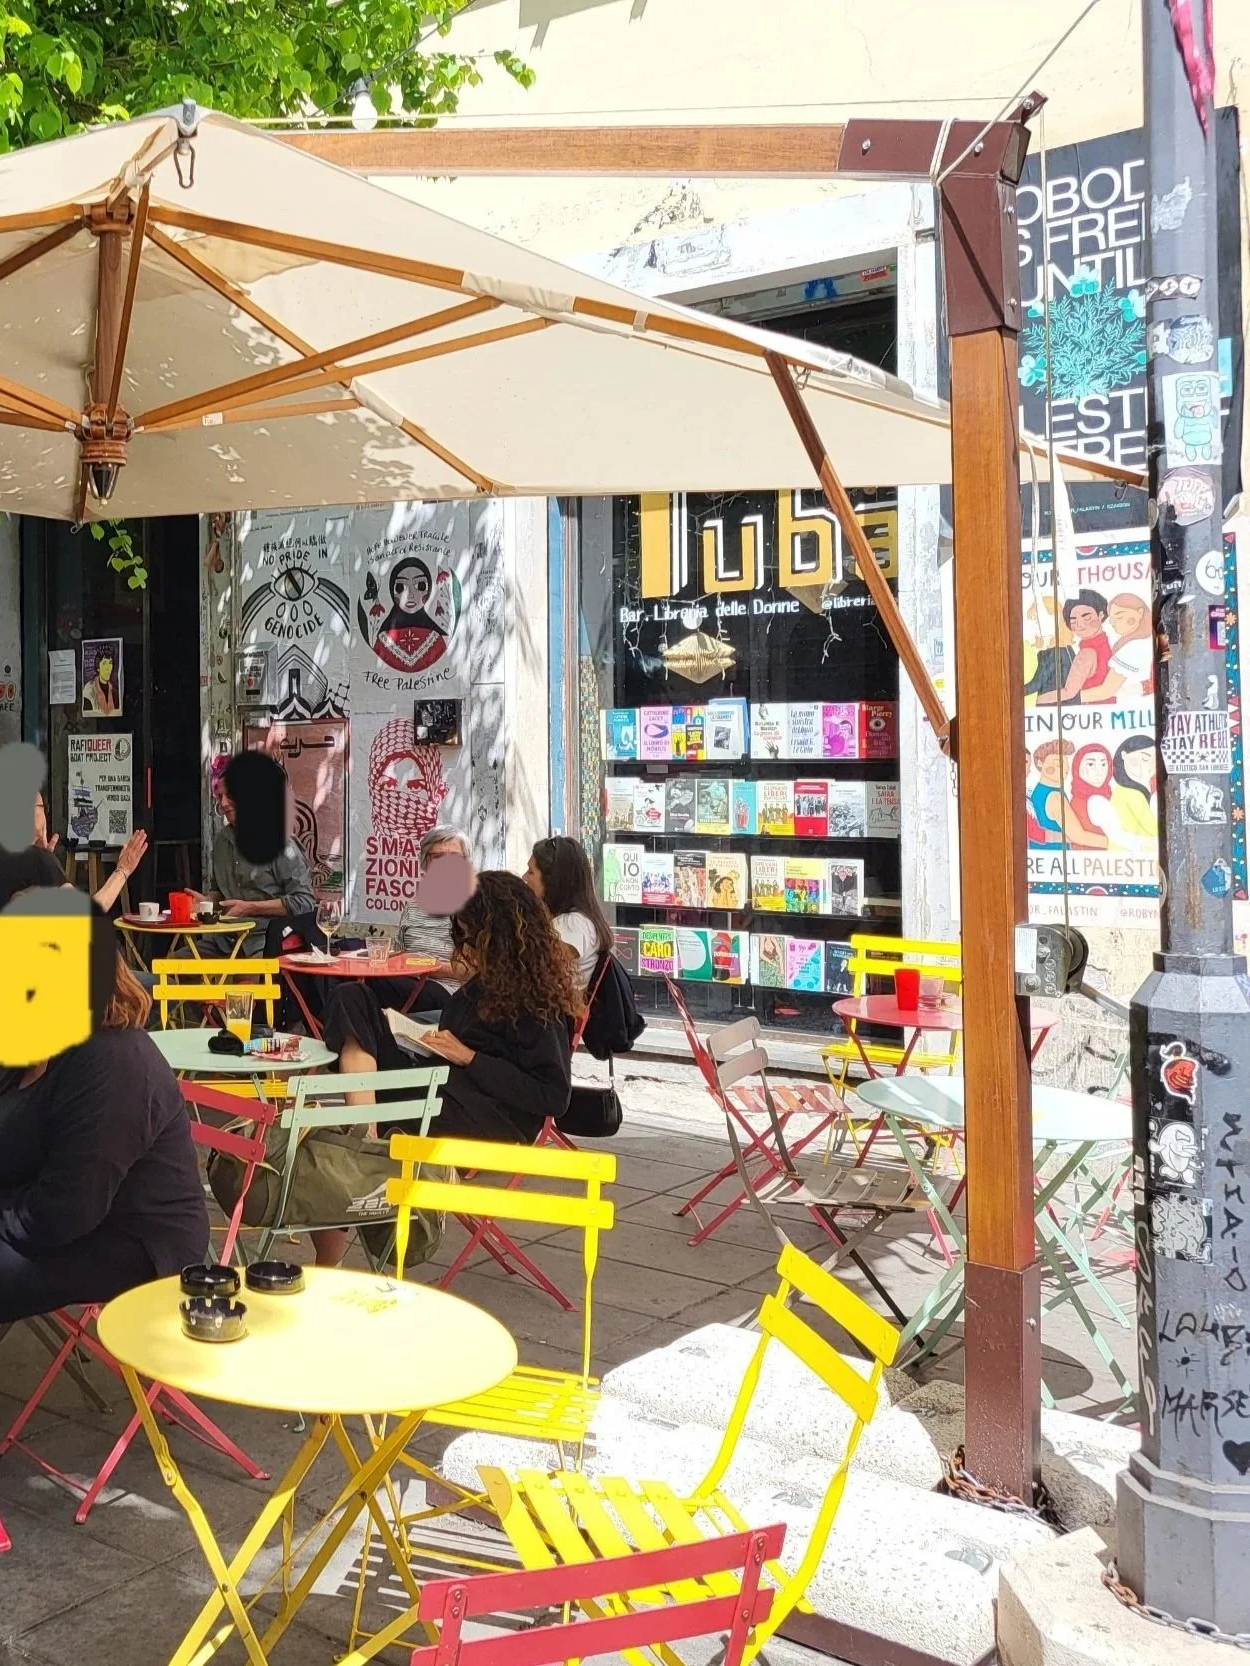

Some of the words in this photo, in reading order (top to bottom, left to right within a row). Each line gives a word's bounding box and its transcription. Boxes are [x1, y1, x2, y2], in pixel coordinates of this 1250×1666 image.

[263, 556, 274, 566] NO
[279, 550, 310, 566] PRIDE
[319, 548, 328, 559] IN
[716, 600, 747, 617] delle
[753, 599, 800, 615] Donne
[264, 617, 324, 639] GENOCIDE
[1025, 713, 1053, 732] IN
[1061, 712, 1103, 730] OUR
[1161, 735, 1195, 750] STAY
[1199, 730, 1228, 749] REBEL
[624, 853, 638, 863] QUI
[1050, 857, 1080, 875] ALL
[366, 858, 426, 878] ZIONI
[623, 863, 640, 877] IO
[643, 942, 672, 958] CARO
[641, 958, 674, 971] STRONZO
